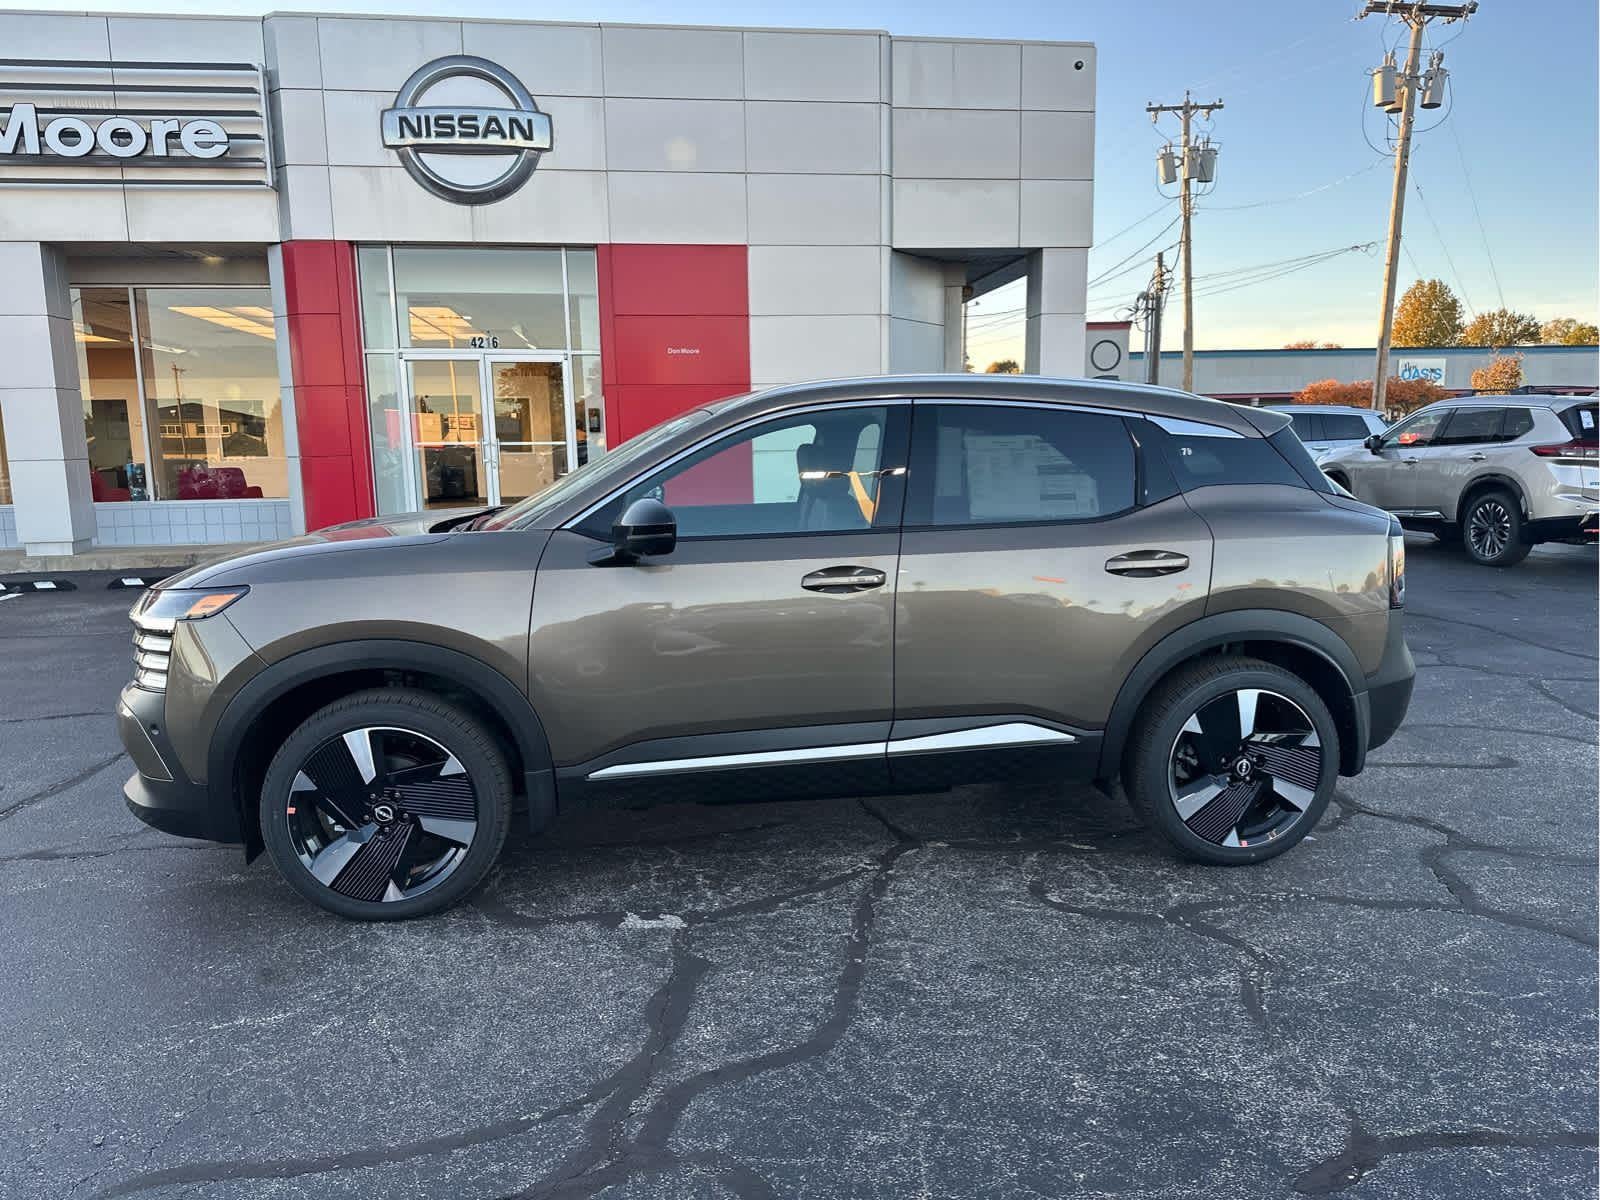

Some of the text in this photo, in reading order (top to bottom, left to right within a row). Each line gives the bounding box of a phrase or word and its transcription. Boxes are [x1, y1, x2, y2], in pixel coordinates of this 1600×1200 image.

[0, 102, 230, 159] Moore
[398, 114, 535, 141] NISSAN
[470, 336, 499, 349] 4216
